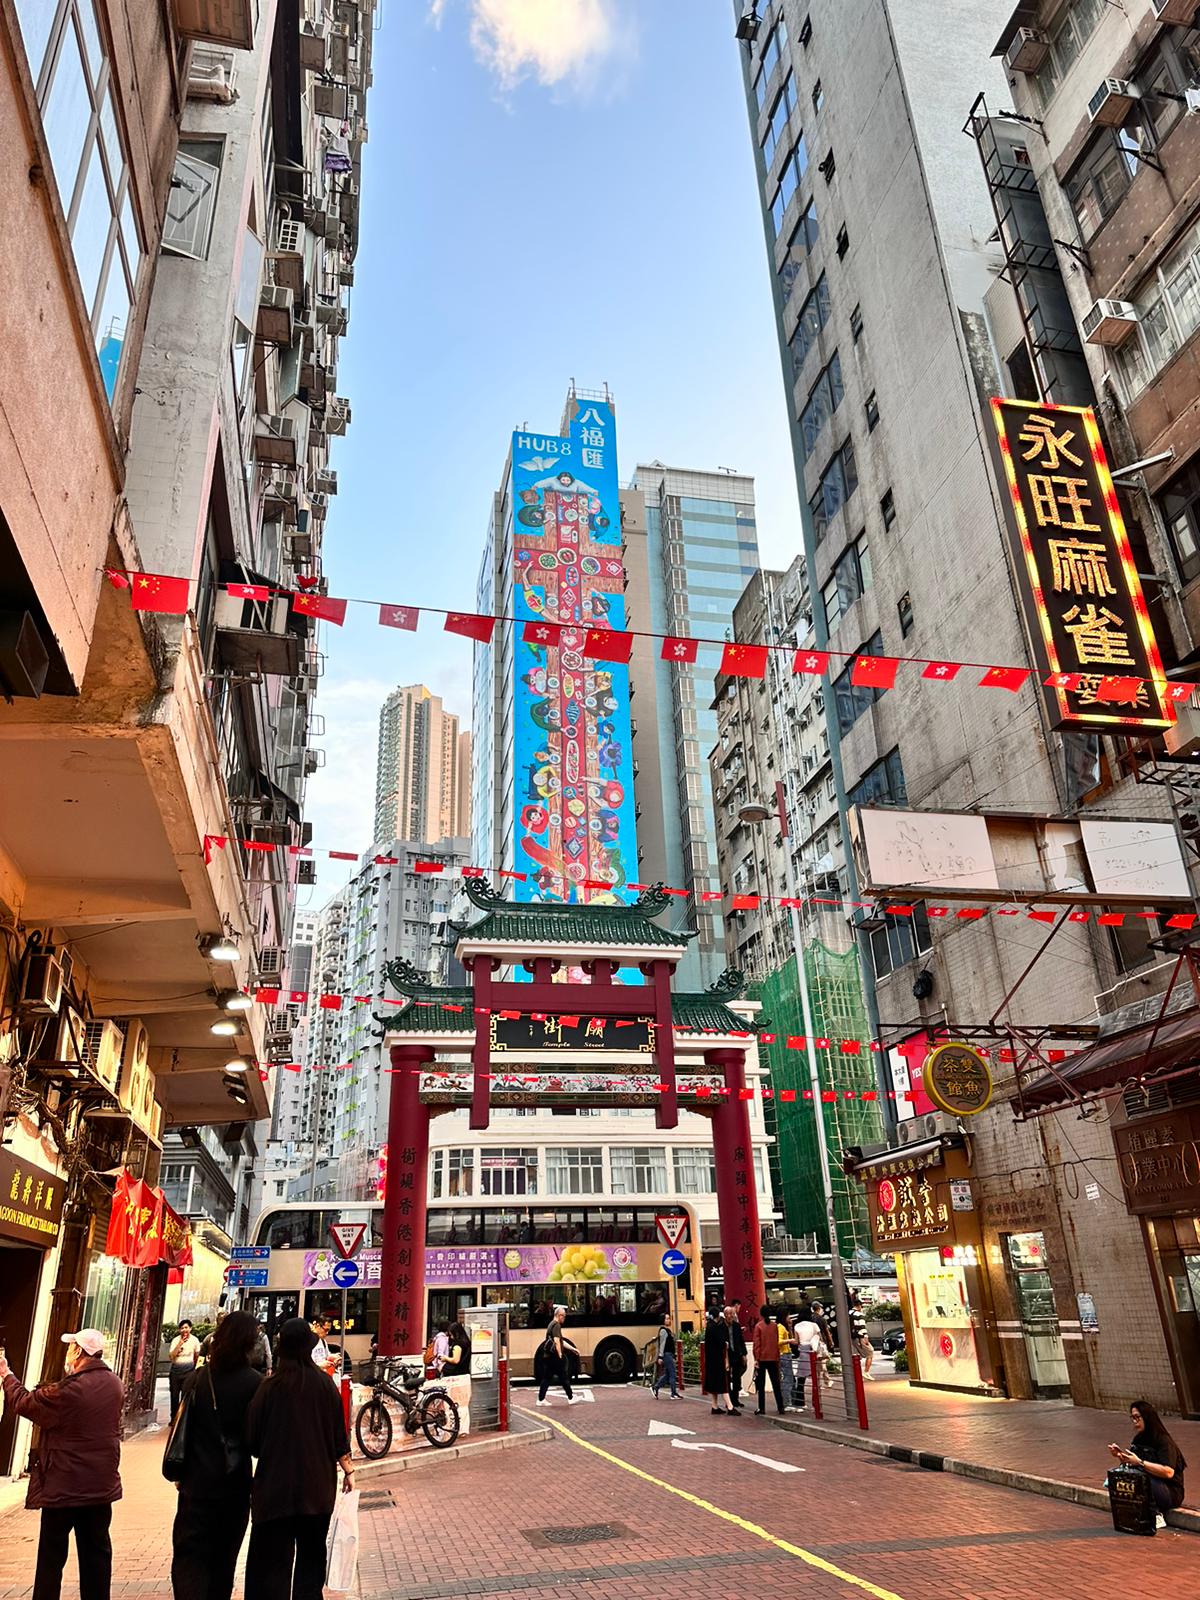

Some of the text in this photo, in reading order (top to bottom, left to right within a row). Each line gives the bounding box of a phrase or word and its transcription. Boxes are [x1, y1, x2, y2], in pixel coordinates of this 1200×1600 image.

[580, 407, 605, 469] 八福匯
[1019, 413, 1136, 666] 永旺麻雀
